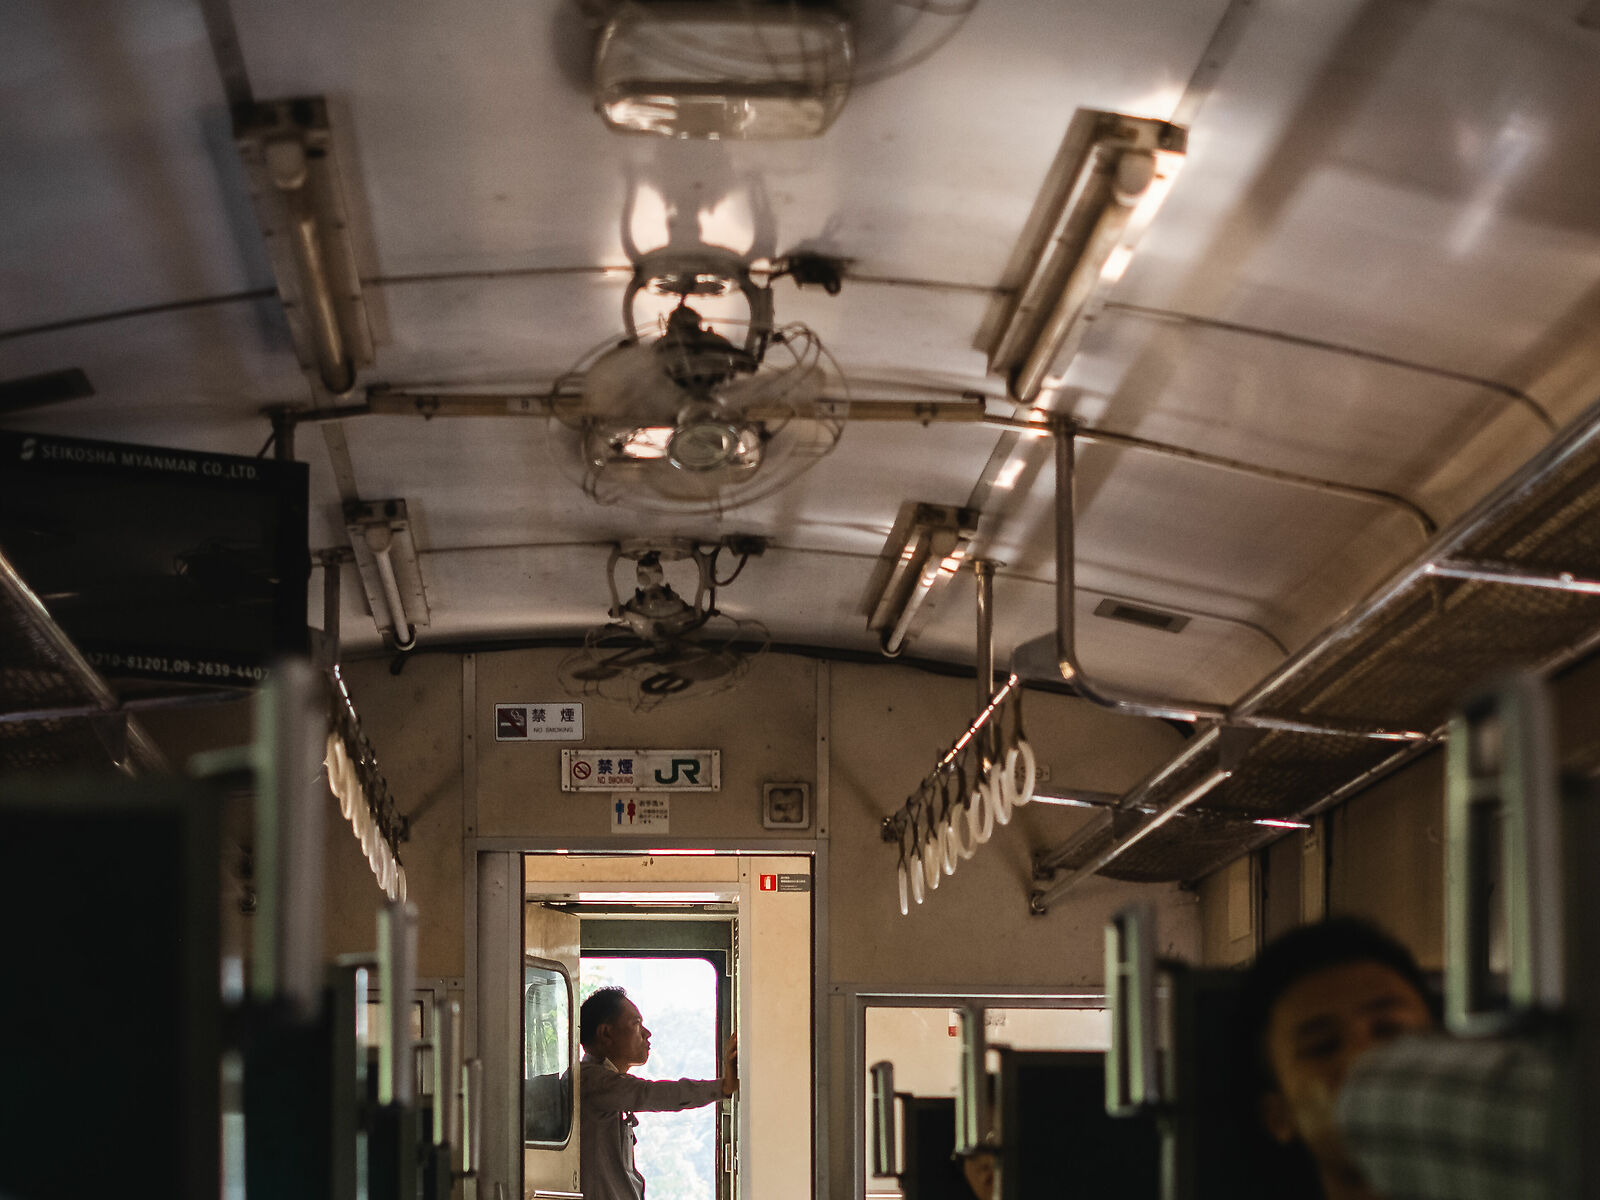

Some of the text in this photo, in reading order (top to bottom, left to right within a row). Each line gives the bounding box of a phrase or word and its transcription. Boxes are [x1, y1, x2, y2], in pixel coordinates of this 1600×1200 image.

[41, 444, 116, 463] SEIKOSHA
[121, 452, 196, 473] MYANMAR
[532, 708, 575, 722] 禁煙
[598, 759, 633, 775] 禁煙
[655, 759, 700, 784] JR
[597, 776, 634, 784] NO SMOKING
